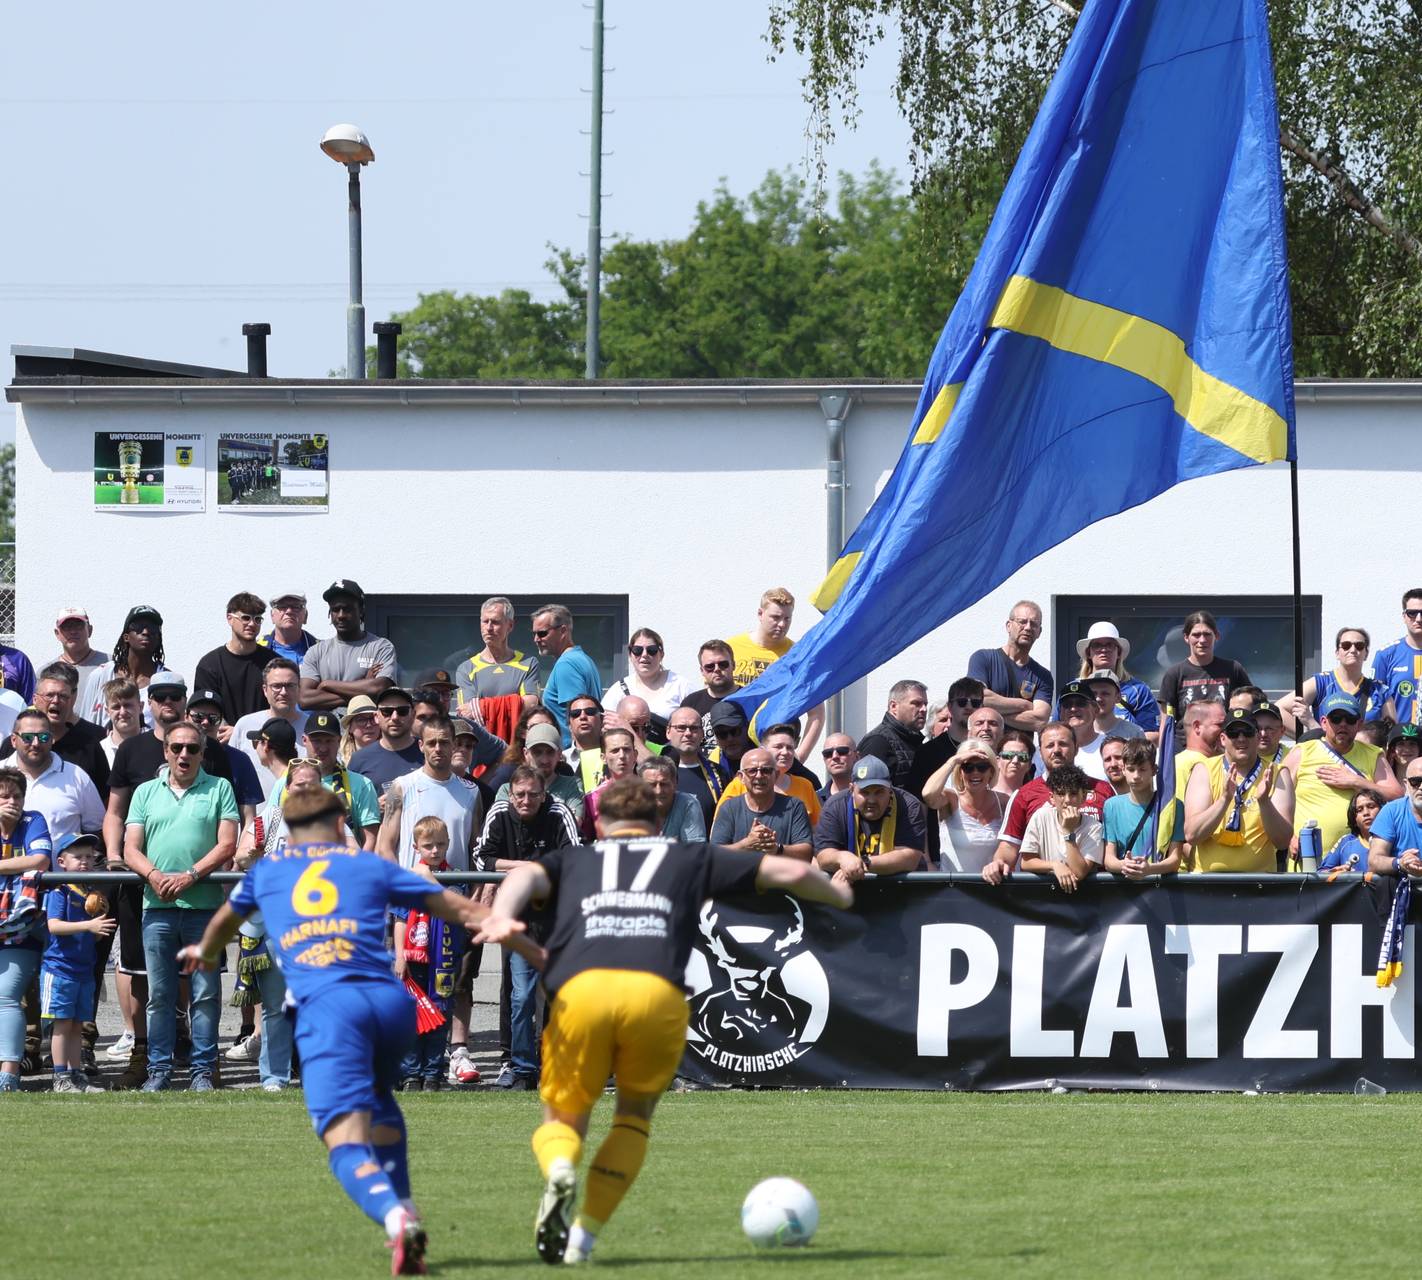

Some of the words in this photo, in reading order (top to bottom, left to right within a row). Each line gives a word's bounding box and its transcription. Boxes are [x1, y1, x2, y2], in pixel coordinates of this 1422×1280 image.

[220, 432, 273, 440] UNVERGESSENE
[275, 432, 311, 440] MOMENTE
[594, 842, 669, 892] 17
[291, 859, 339, 917] 6
[580, 890, 673, 916] SCHWERMANN
[279, 917, 358, 951] HARNAFI
[584, 913, 668, 930] therapie
[703, 1042, 801, 1073] PLATZHIRSCHE
